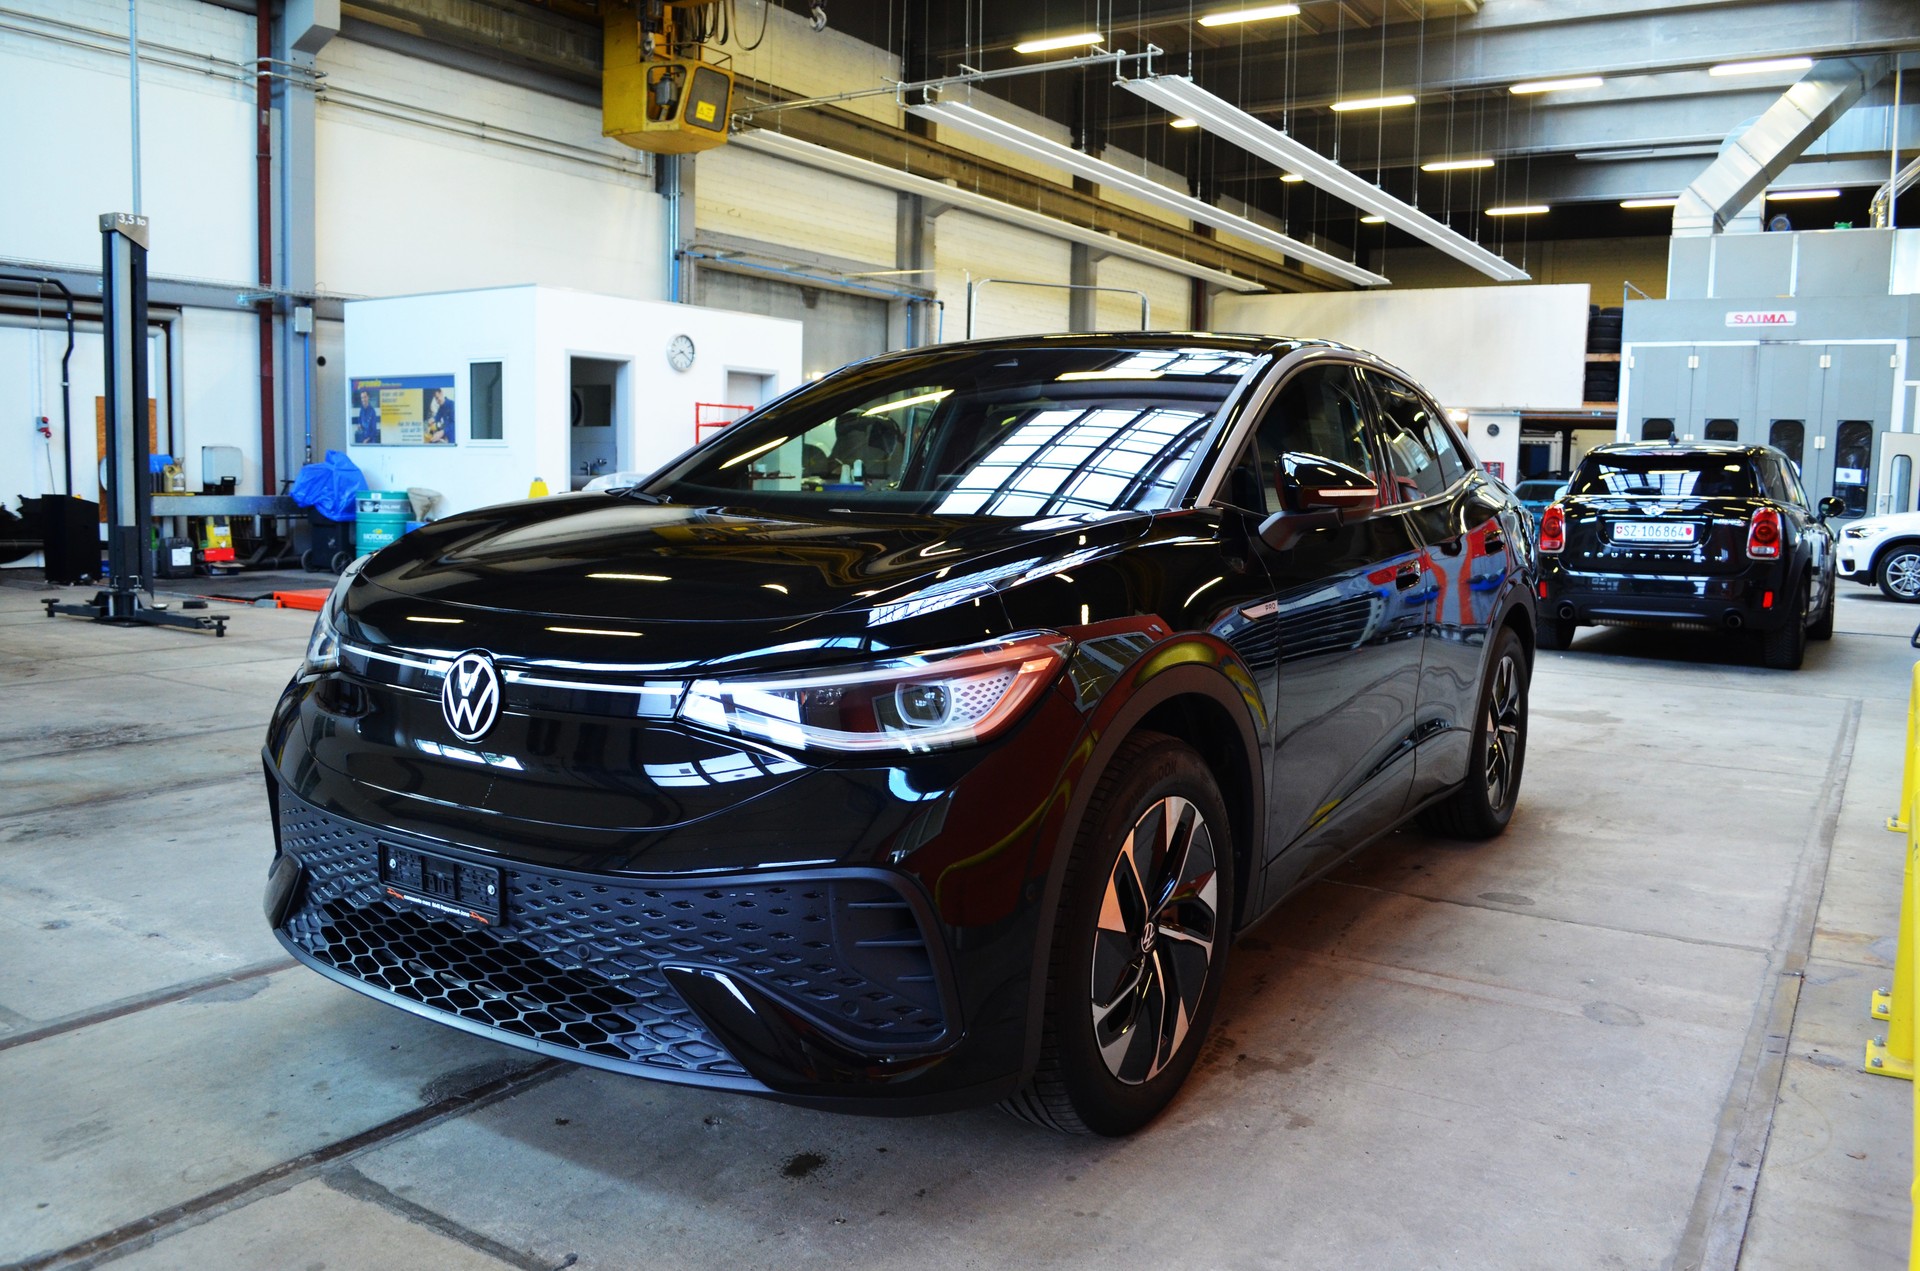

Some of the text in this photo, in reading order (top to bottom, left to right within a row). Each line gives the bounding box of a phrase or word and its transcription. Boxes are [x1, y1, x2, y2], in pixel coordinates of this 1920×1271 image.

[118, 213, 147, 226] 3,5 to
[1734, 314, 1788, 324] SAIMA
[1583, 551, 1723, 562] COUNTRYMAN
[1264, 602, 1276, 611] PRO
